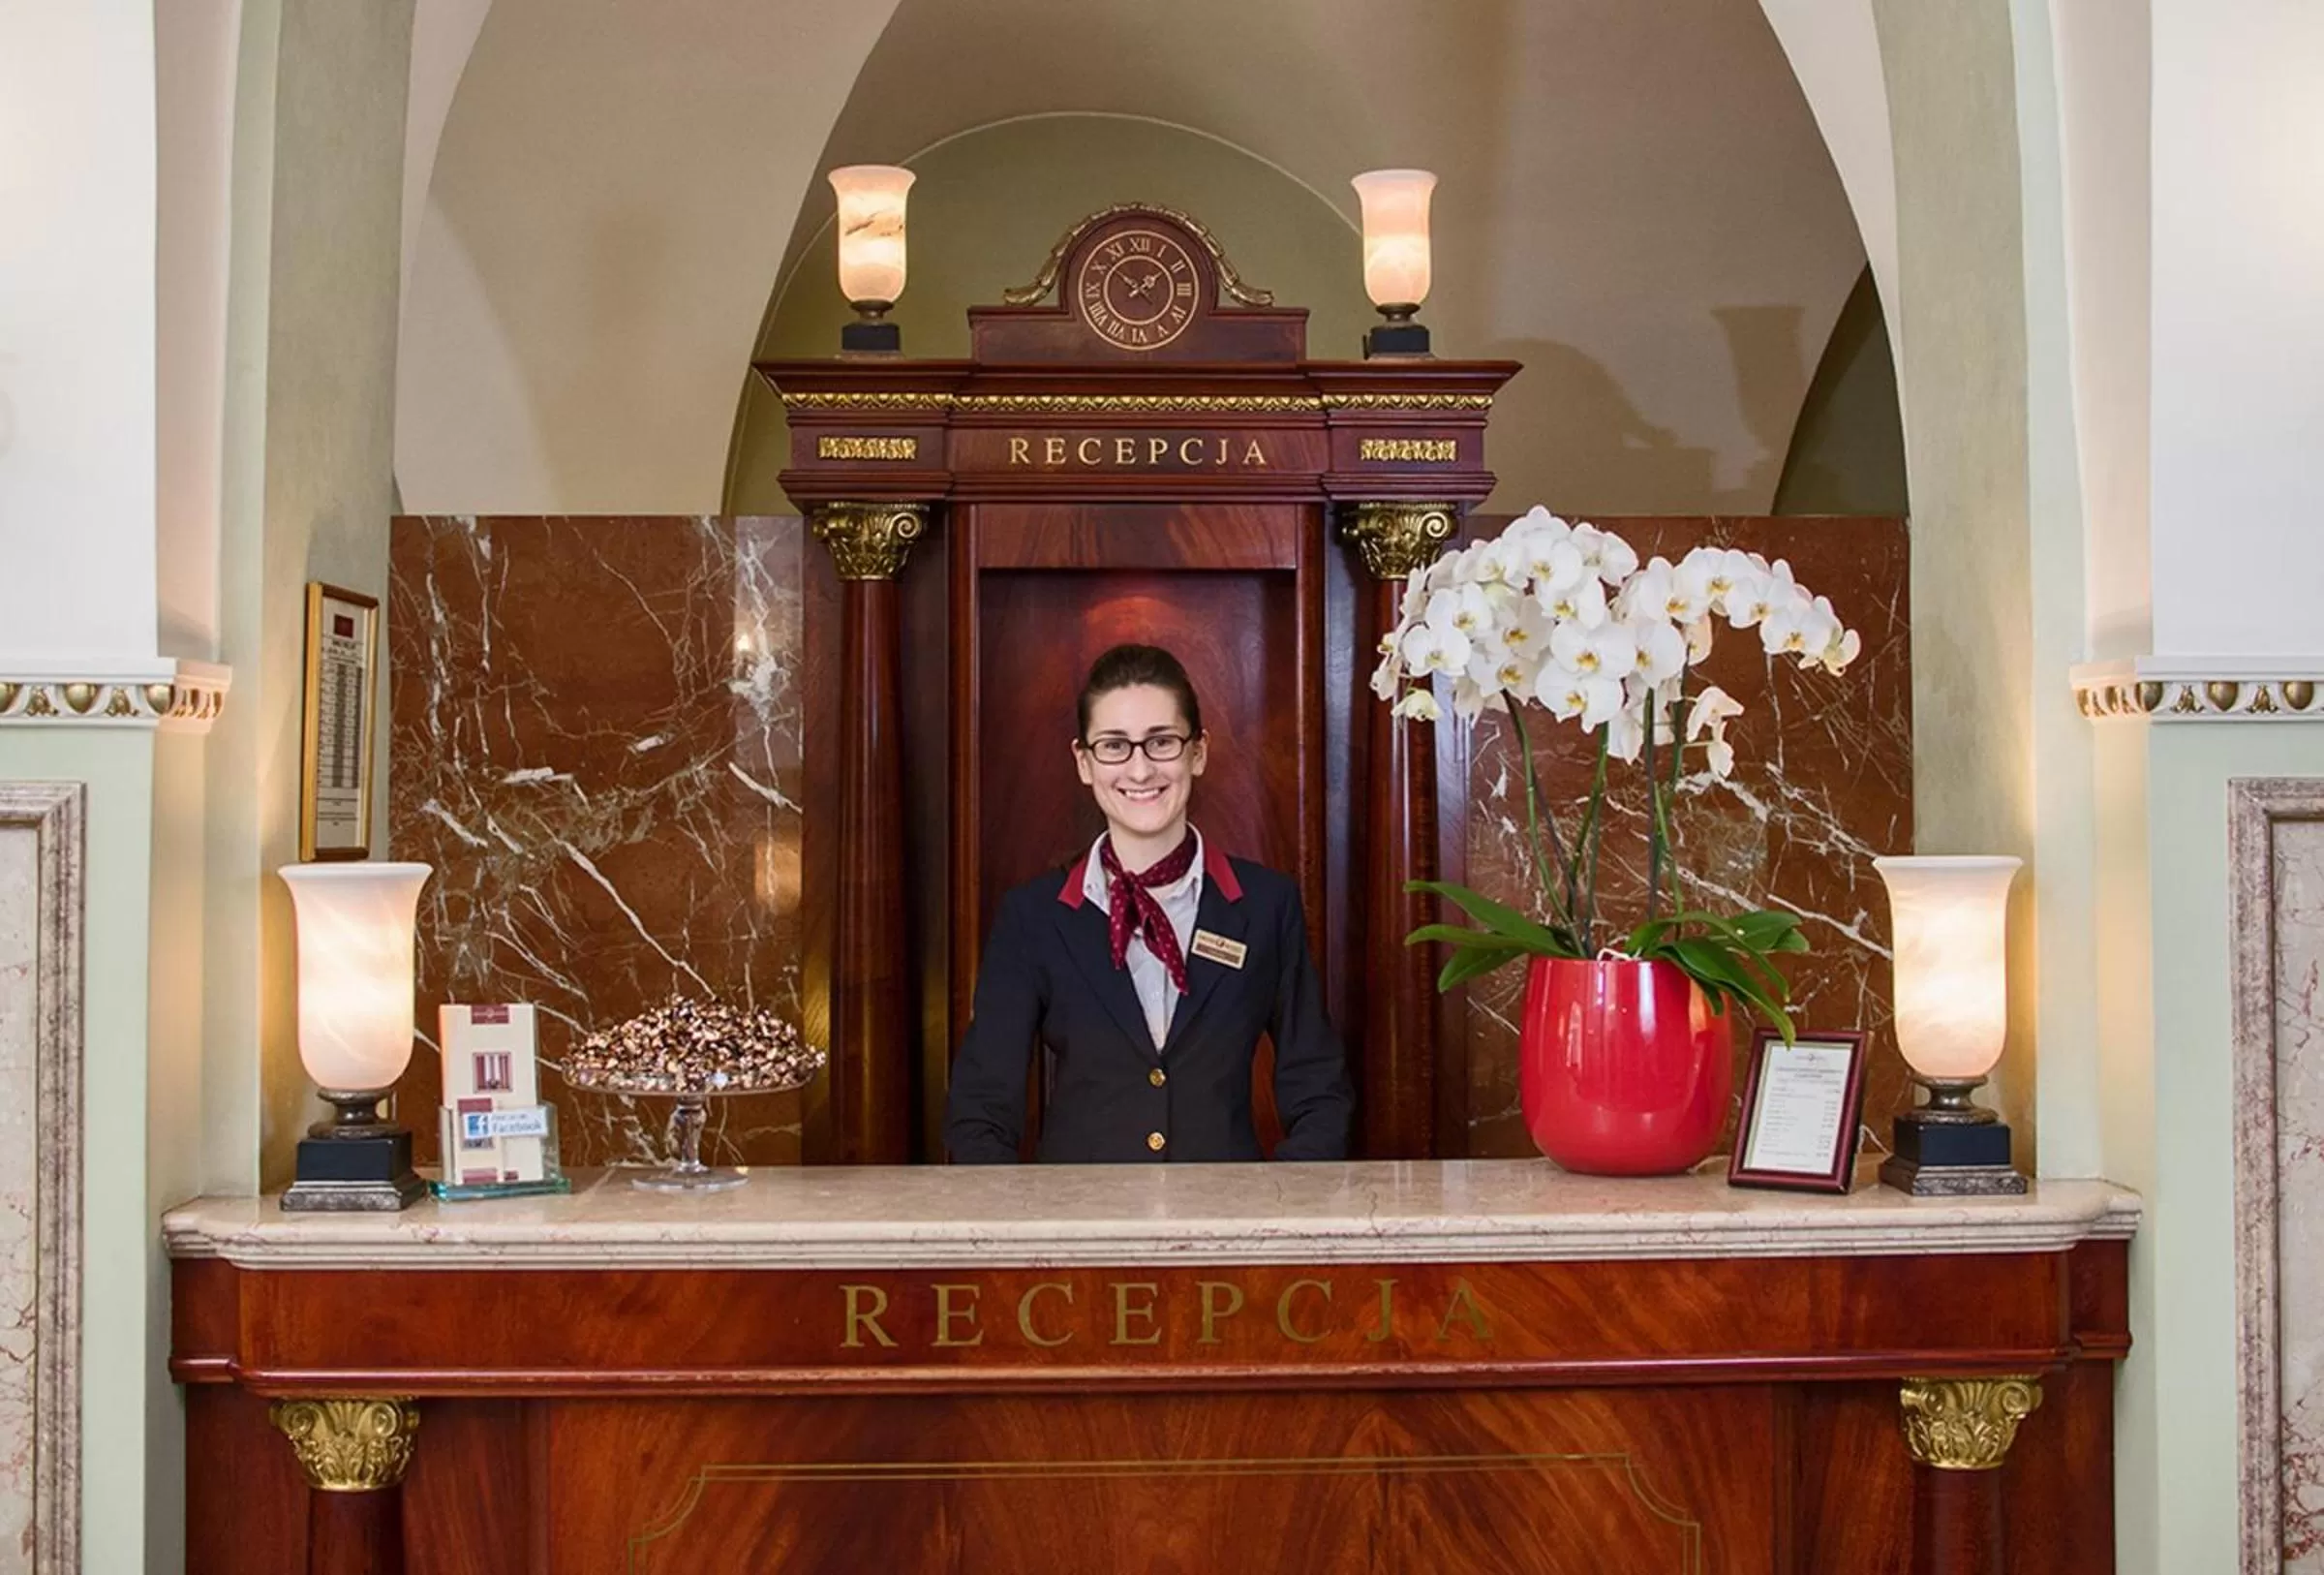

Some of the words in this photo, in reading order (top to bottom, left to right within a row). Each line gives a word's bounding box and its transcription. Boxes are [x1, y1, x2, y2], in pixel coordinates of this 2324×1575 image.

[1105, 241, 1124, 262] XI
[1130, 237, 1150, 253] XII
[1156, 244, 1167, 258] I
[1090, 261, 1107, 275] X
[1171, 260, 1185, 273] II
[1086, 282, 1101, 298] IX
[1176, 282, 1192, 296] III
[1088, 301, 1109, 326] VIII
[1171, 305, 1186, 324] IV
[1107, 321, 1125, 340] VII
[1131, 327, 1147, 343] VI
[1156, 324, 1169, 338] V
[1009, 438, 1268, 465] RECEPCJA
[839, 1279, 1494, 1347] RECEPCJA
